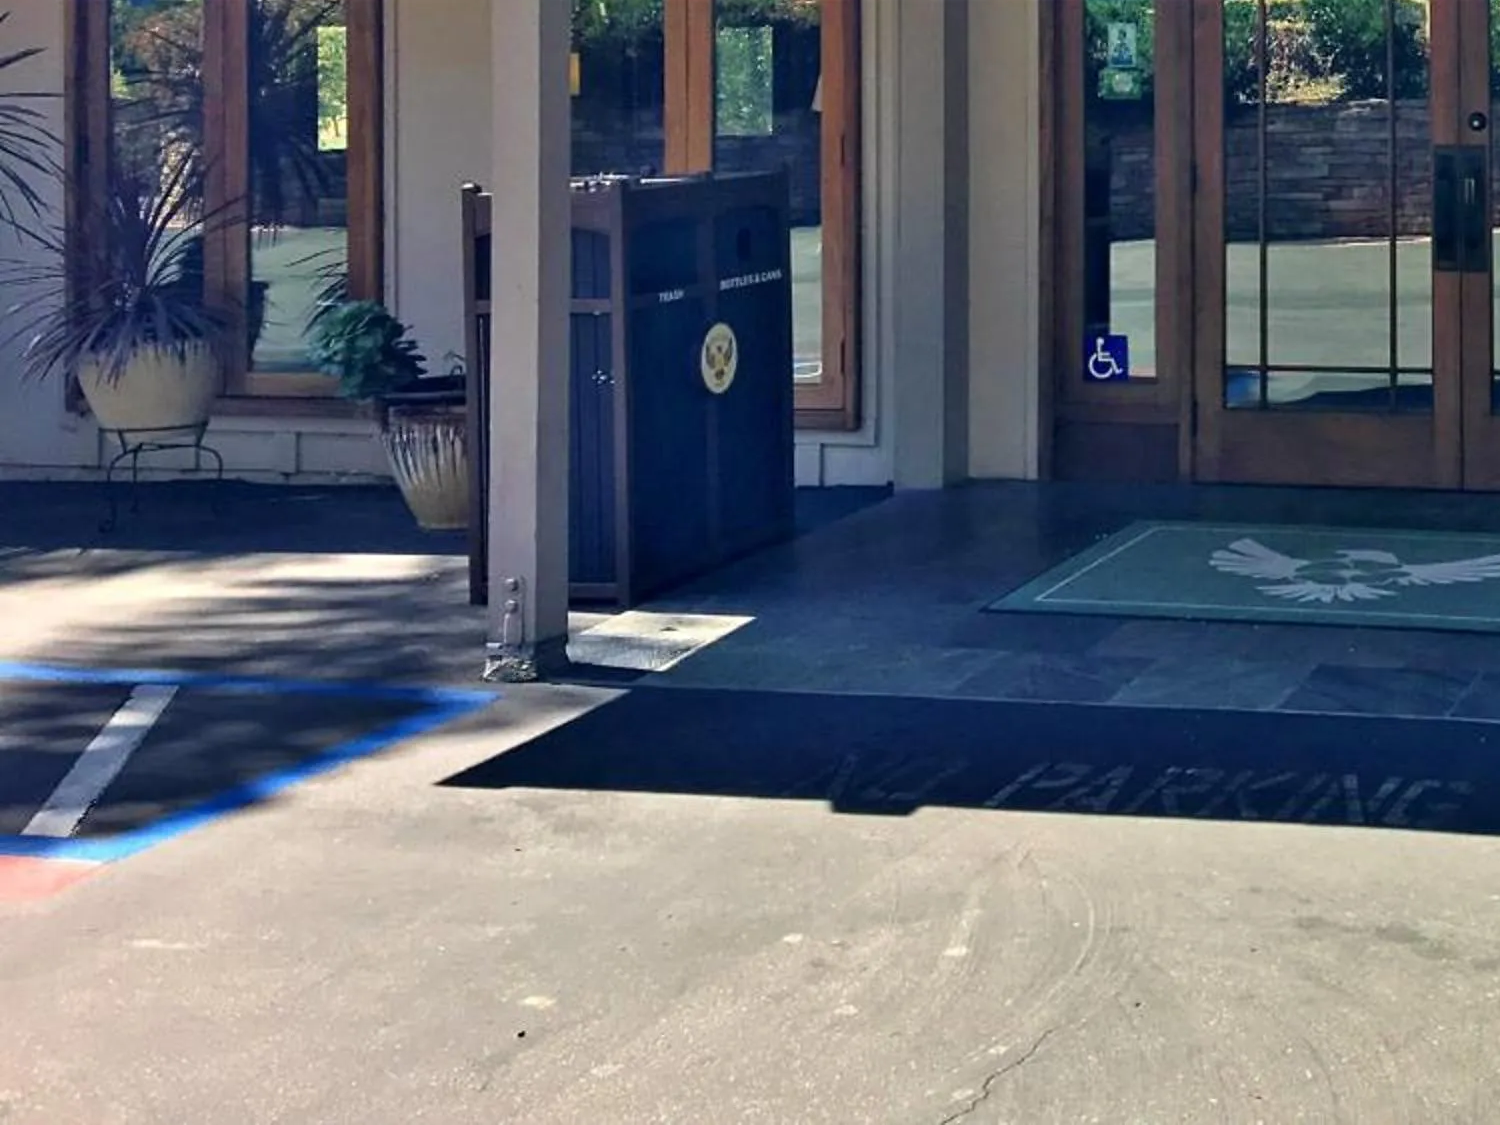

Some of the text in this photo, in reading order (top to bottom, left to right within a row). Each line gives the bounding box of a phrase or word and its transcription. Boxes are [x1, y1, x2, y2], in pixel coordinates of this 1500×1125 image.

[719, 275, 754, 291] BOTTLES
[658, 289, 685, 303] TRASH
[983, 761, 1476, 825] PARKING
